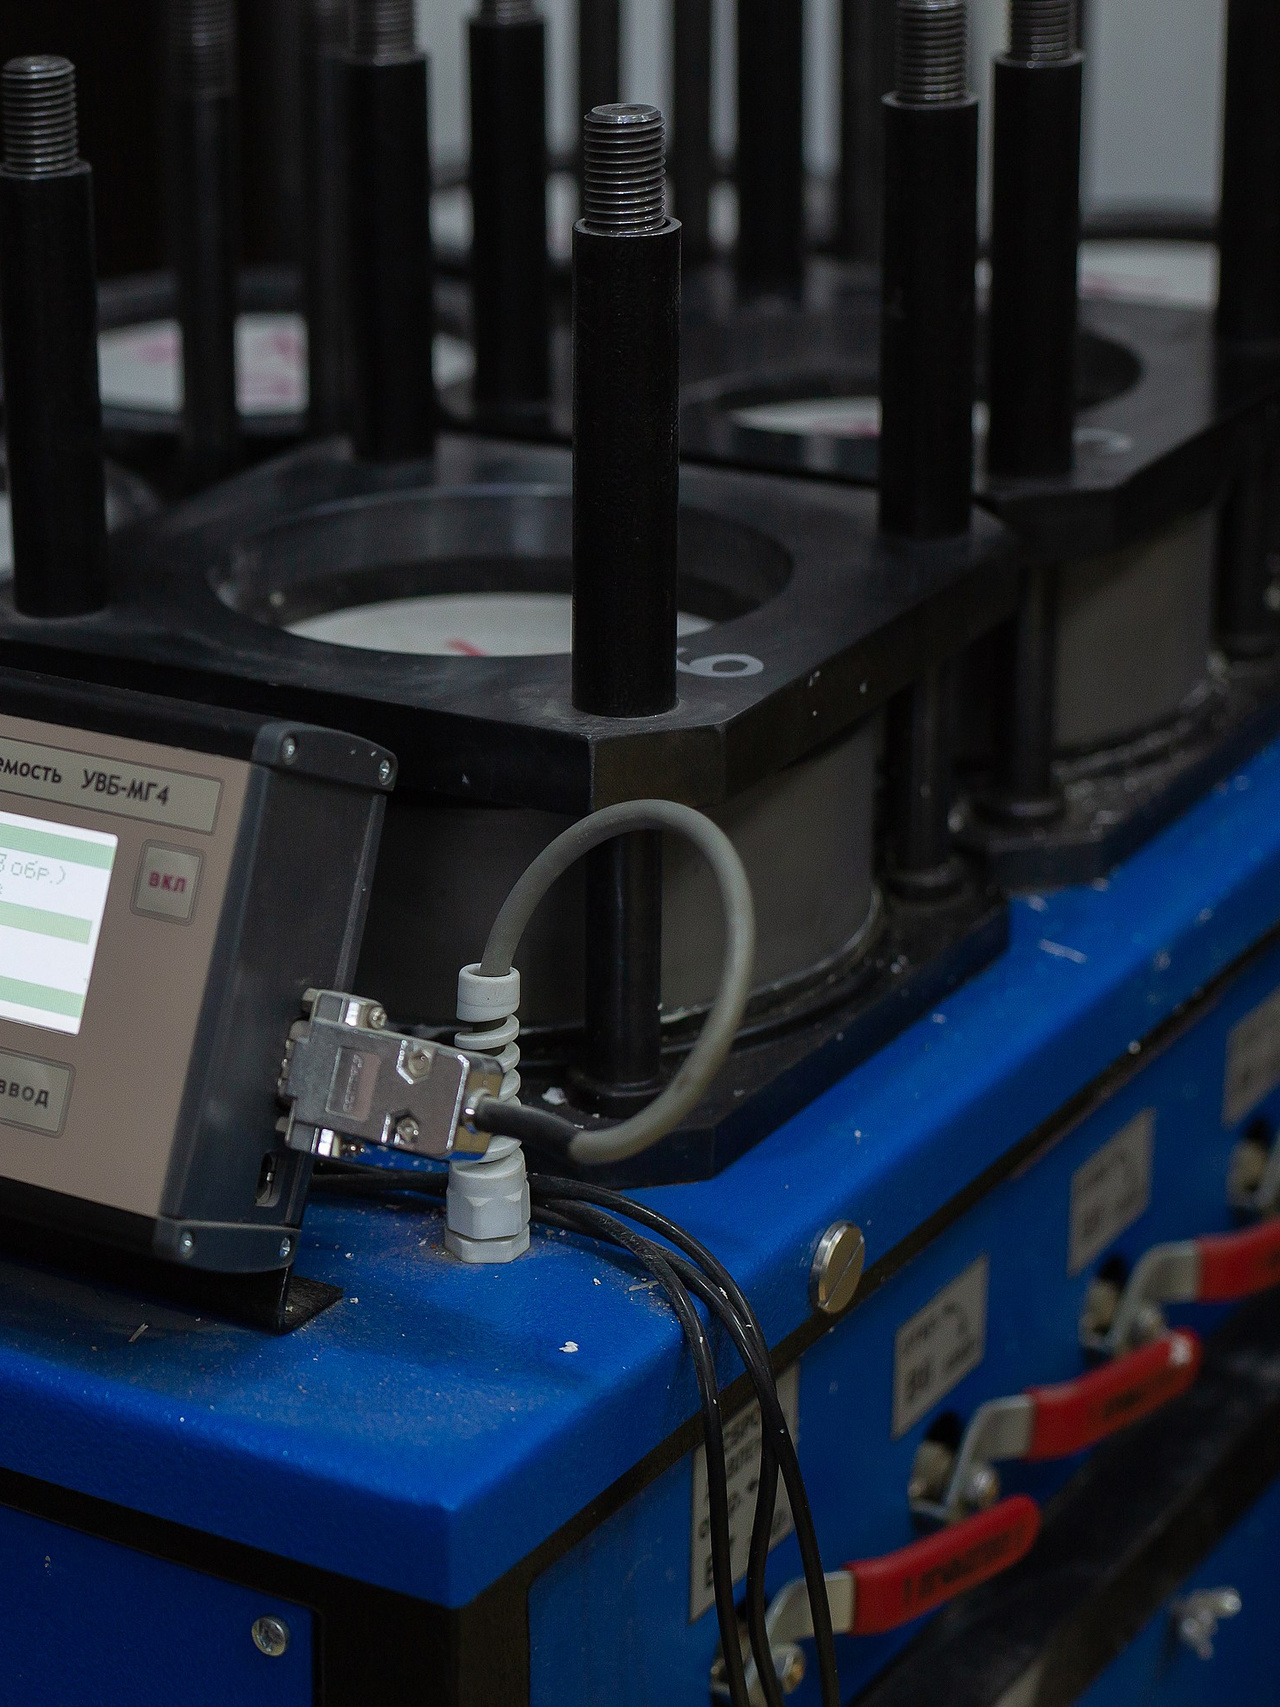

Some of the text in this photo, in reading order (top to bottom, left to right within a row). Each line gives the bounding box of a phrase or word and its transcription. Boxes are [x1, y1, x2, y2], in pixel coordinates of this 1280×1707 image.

[80, 769, 170, 806] УВБ-МГ4
[10, 860, 66, 885] обр.)
[148, 871, 187, 893] ВКЛ
